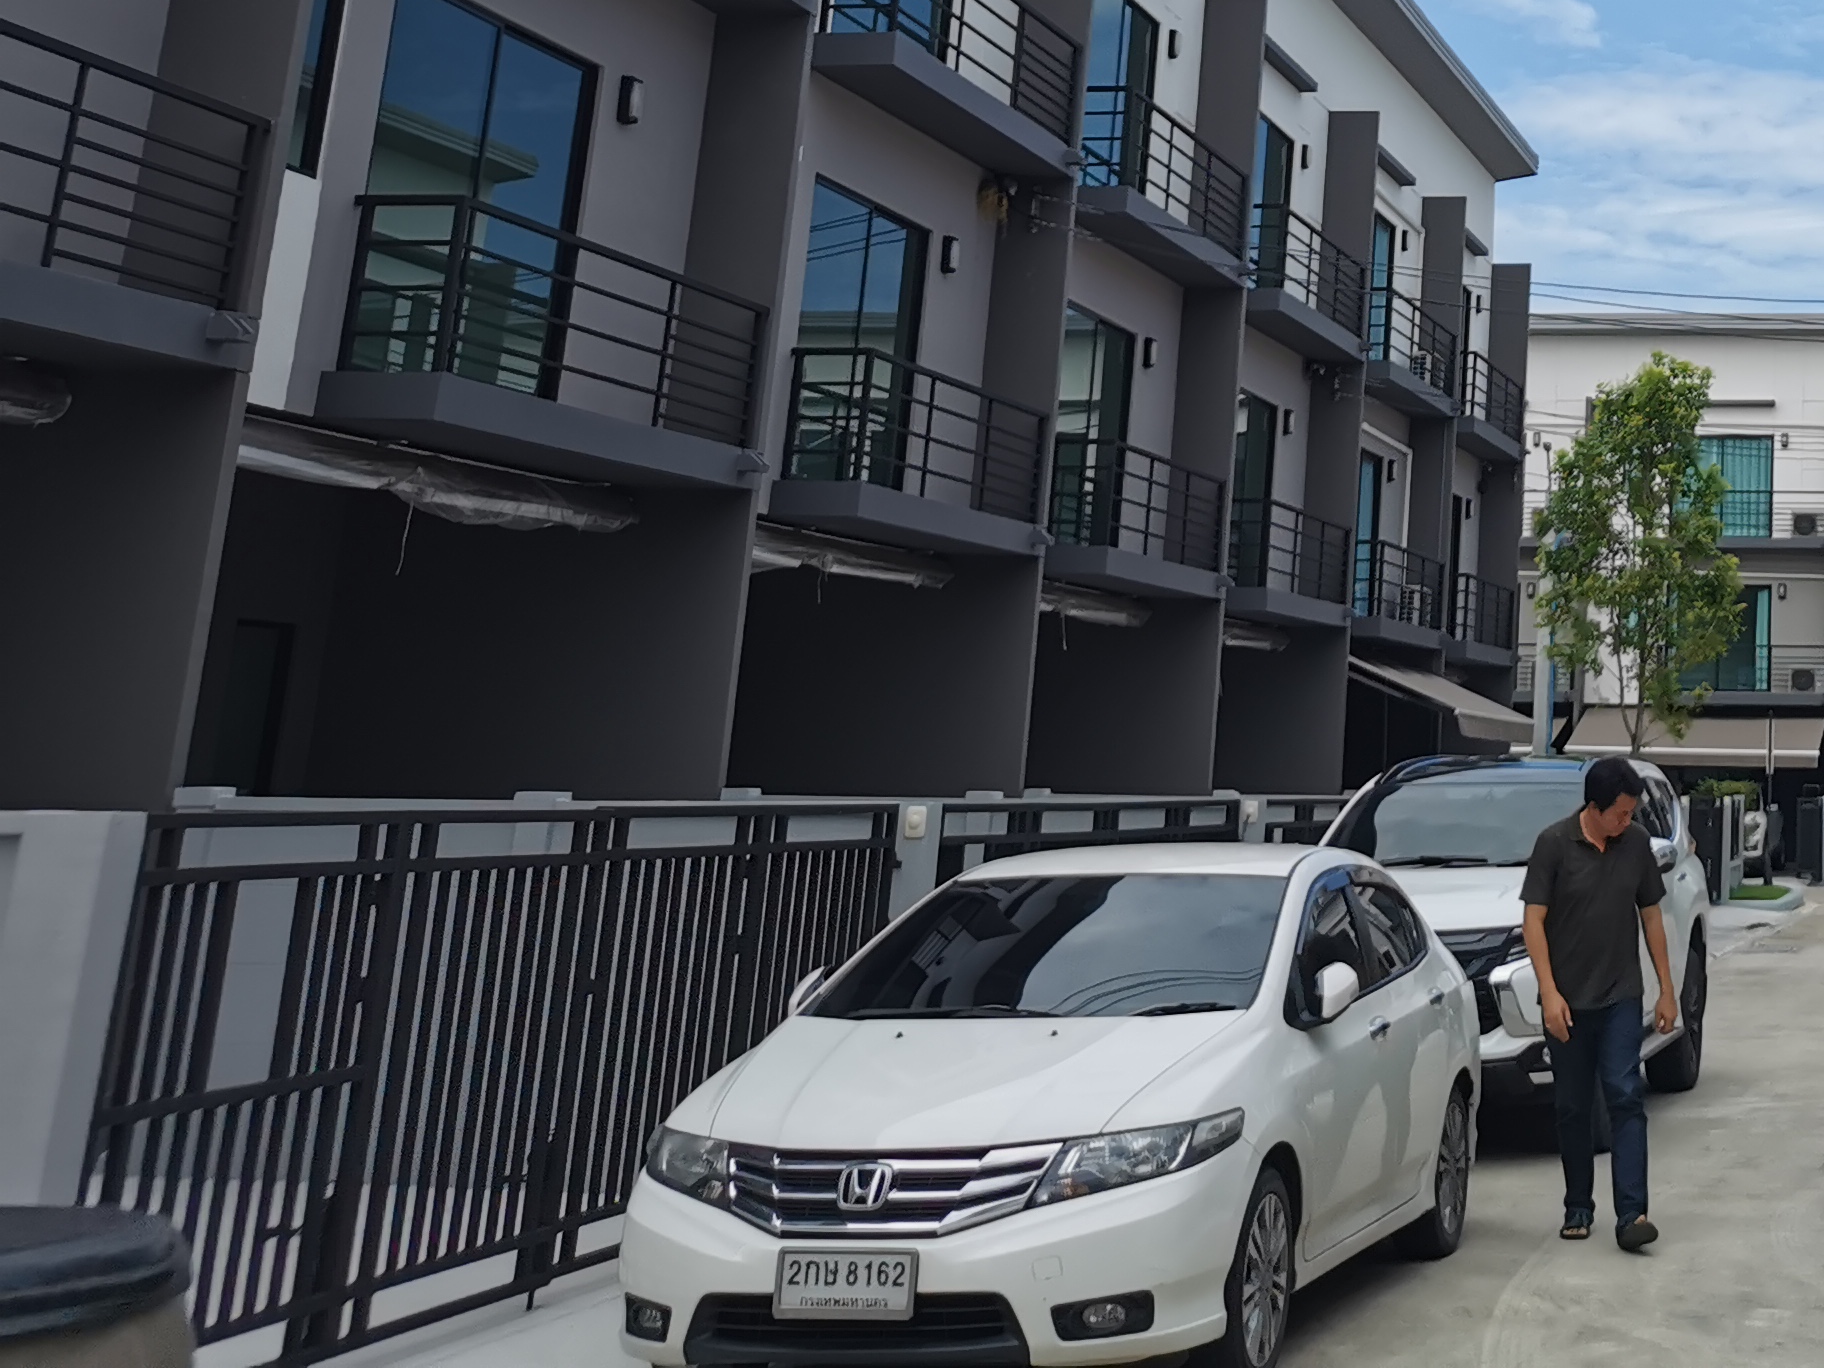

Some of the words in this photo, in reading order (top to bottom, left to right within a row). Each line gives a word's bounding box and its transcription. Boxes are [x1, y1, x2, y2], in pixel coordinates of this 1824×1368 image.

[845, 1260, 905, 1287] 8162
[799, 1296, 889, 1309] กรงเทพมหานคร
